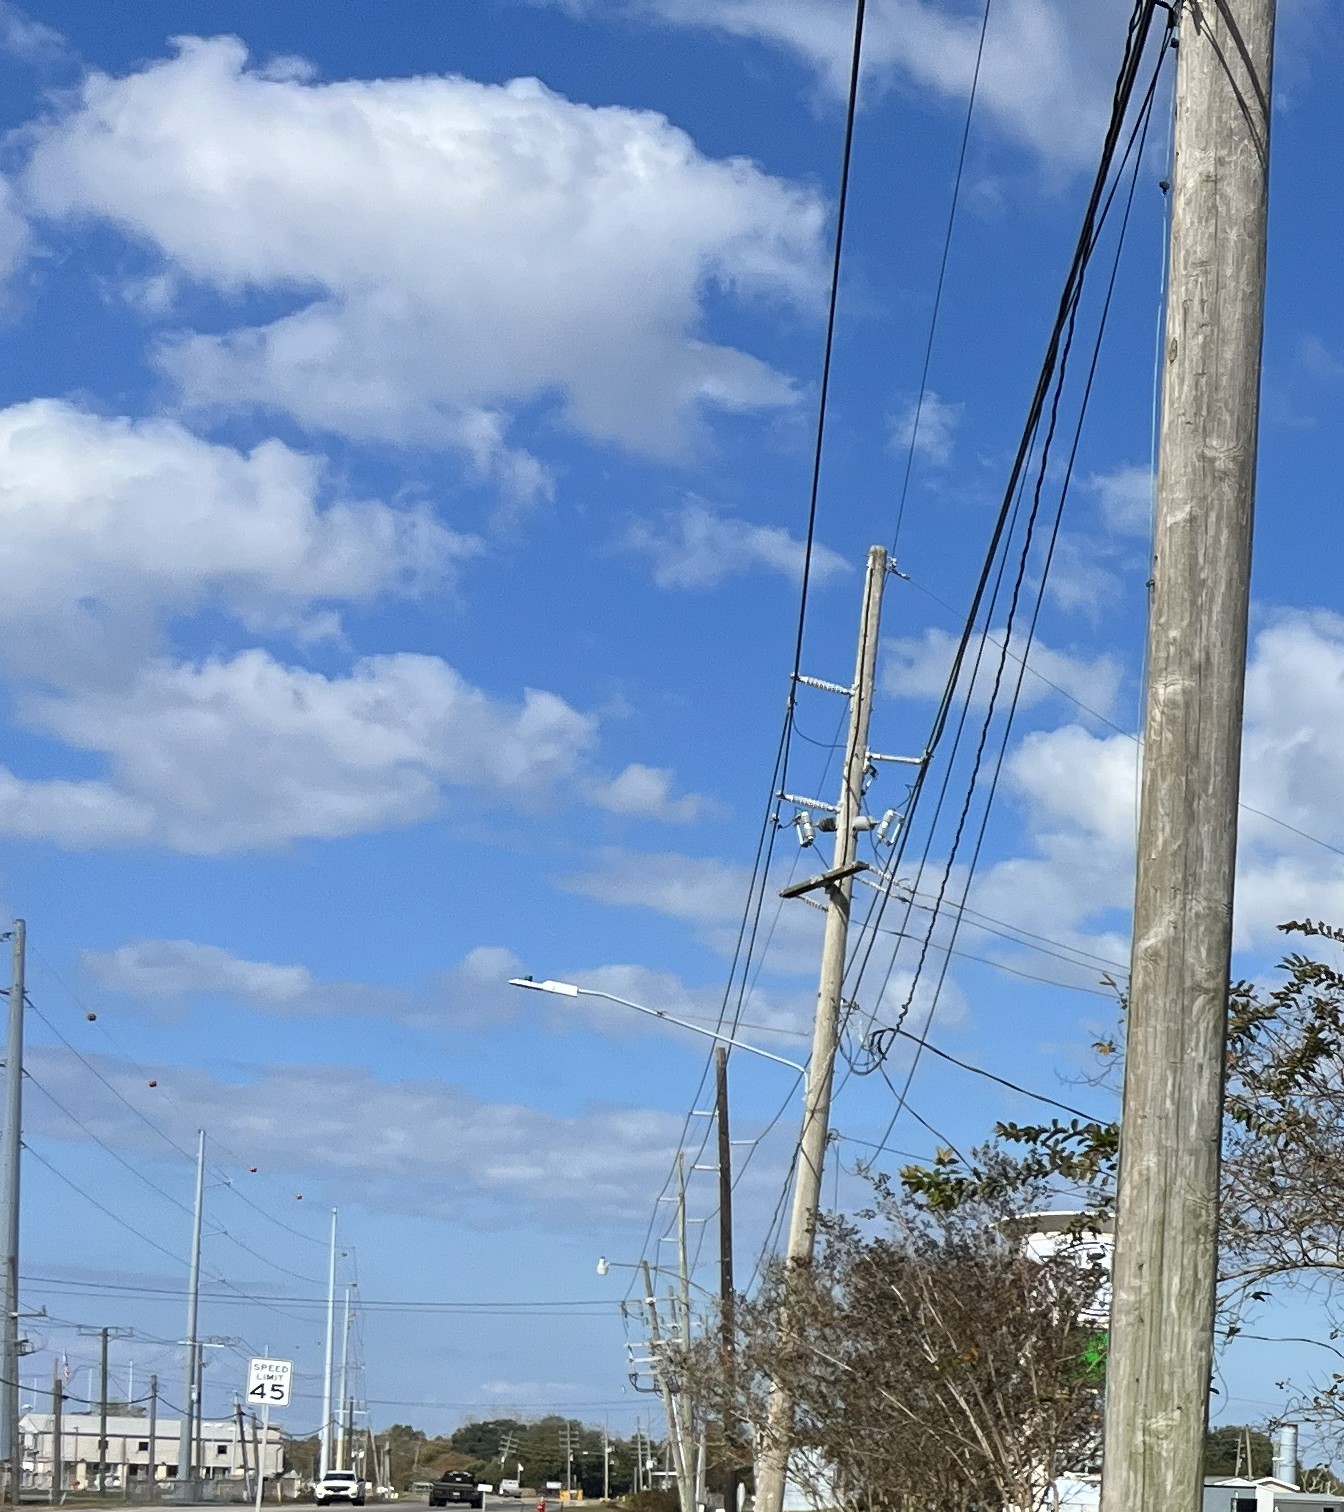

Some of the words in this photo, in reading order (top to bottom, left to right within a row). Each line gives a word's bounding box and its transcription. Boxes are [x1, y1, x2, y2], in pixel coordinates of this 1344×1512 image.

[254, 1364, 288, 1373] SPEED
[256, 1373, 283, 1381] LIMIT
[250, 1383, 284, 1400] 45
